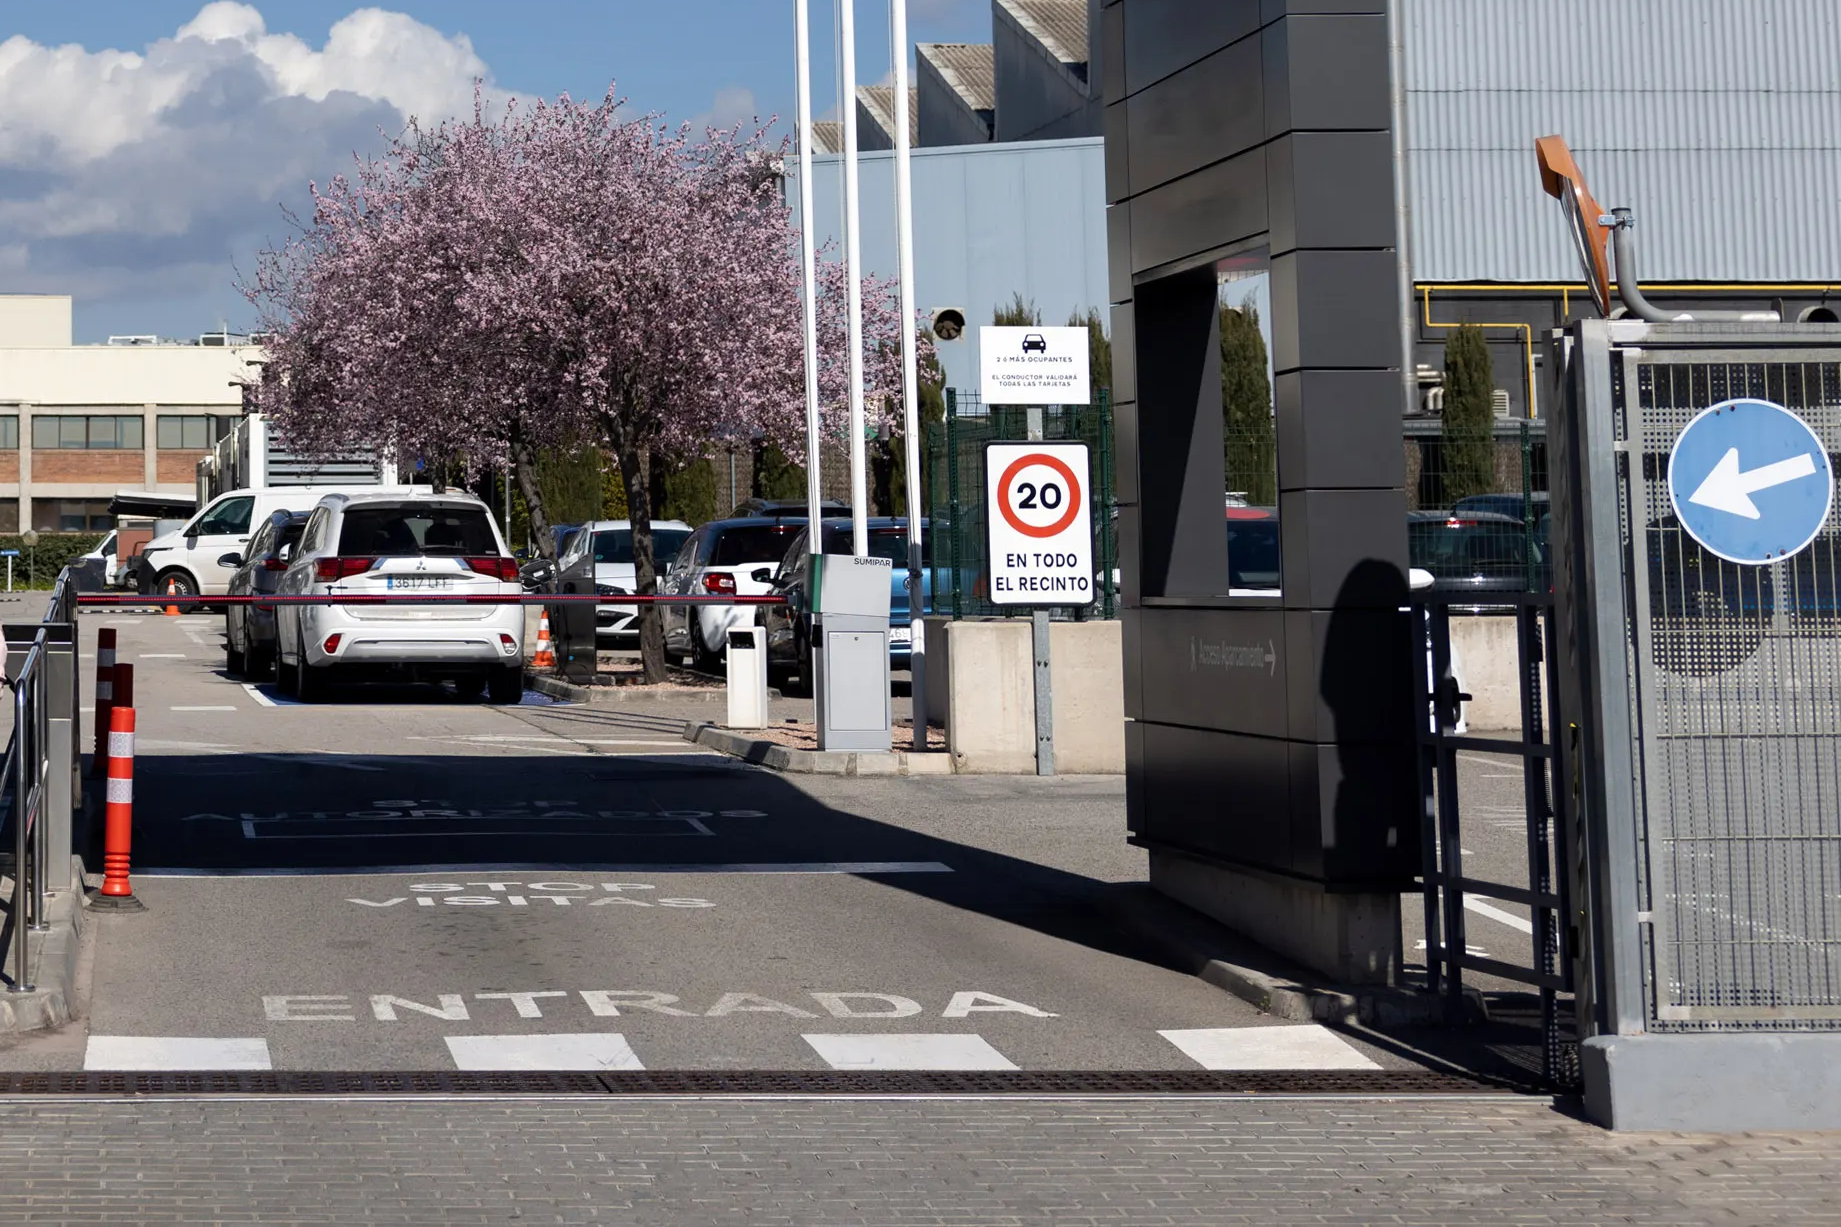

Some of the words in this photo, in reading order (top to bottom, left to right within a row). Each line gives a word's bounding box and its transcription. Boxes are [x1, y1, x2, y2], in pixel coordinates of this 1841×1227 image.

[1017, 482, 1062, 510] 20
[854, 557, 891, 567] SUMIPAR
[1006, 553, 1027, 568] EN
[1033, 553, 1078, 568] TODO
[395, 577, 425, 589] 3617
[996, 577, 1014, 591] EL
[1019, 577, 1089, 592] RECINTO
[180, 809, 769, 822] AUTORIZADOS
[408, 882, 657, 892] STOP
[344, 895, 718, 909] VISITAS
[261, 989, 1061, 1022] ENTRADA
